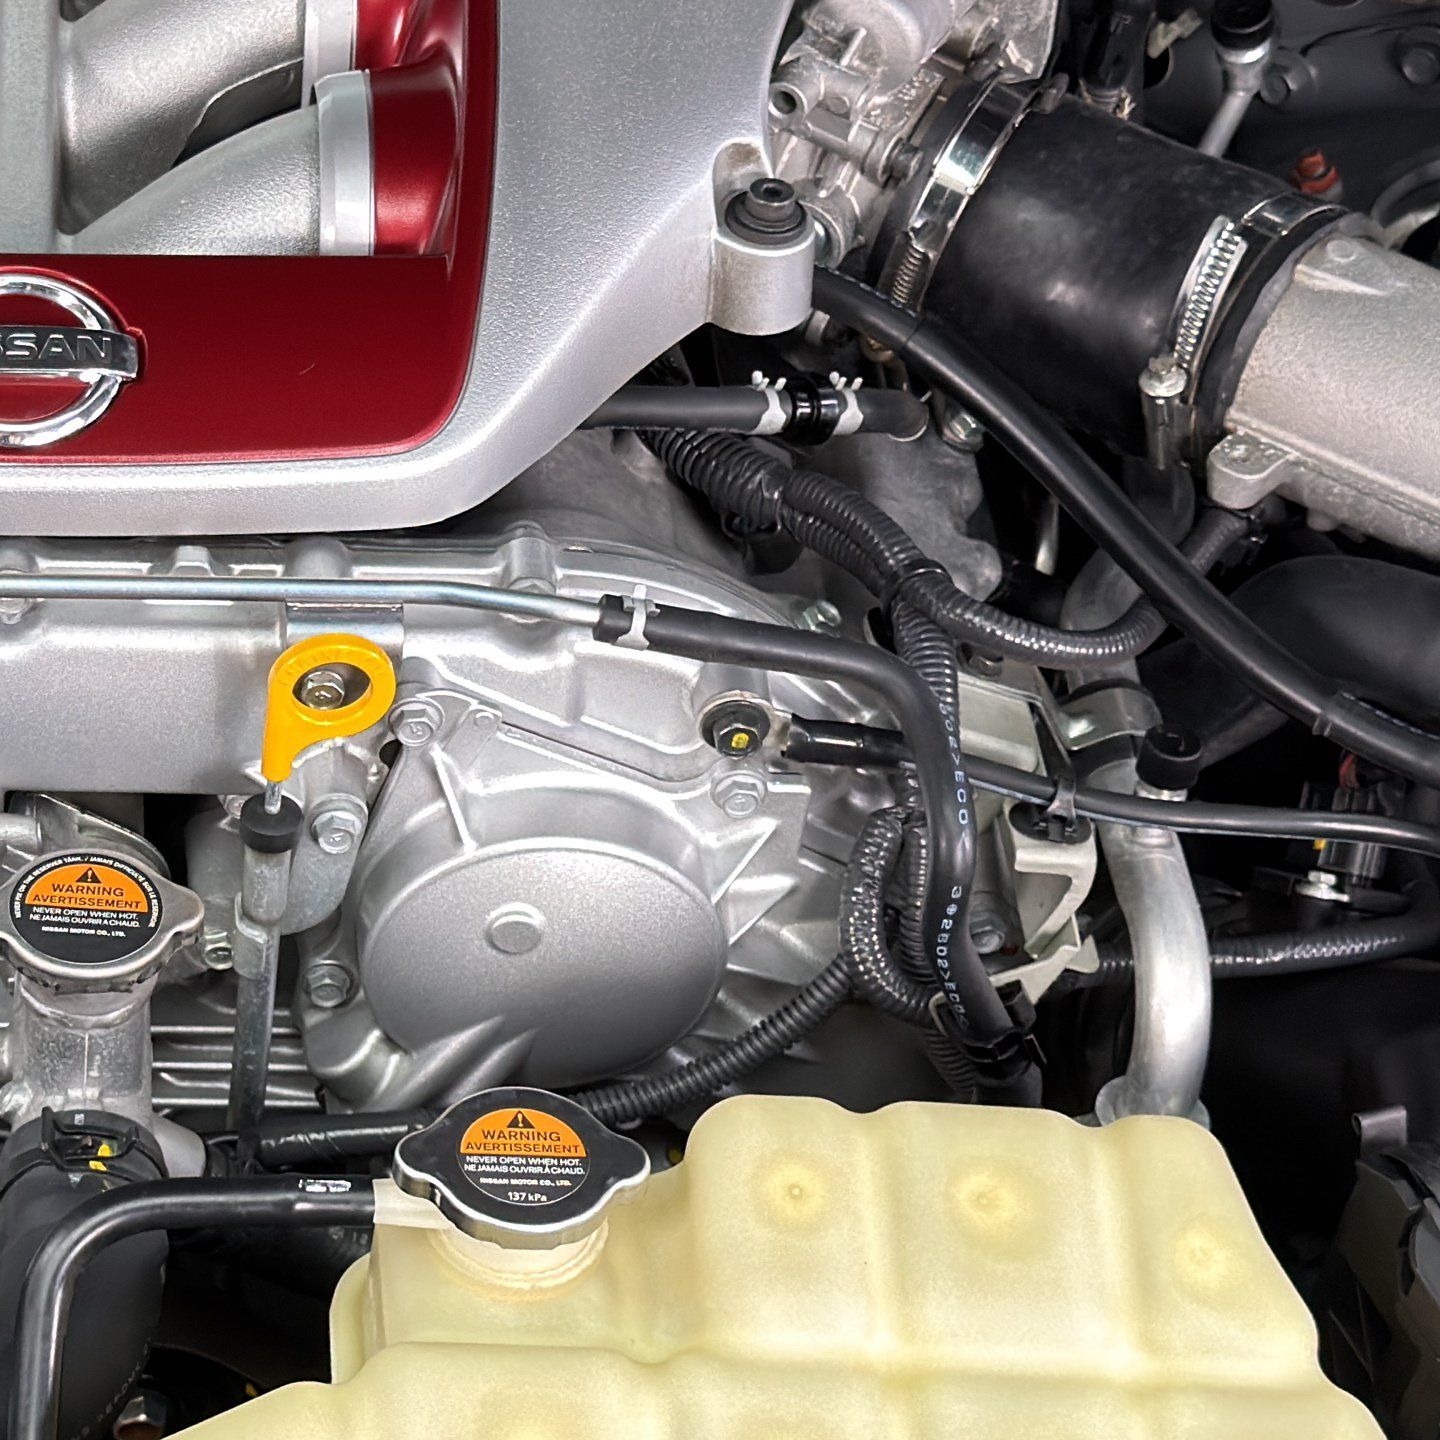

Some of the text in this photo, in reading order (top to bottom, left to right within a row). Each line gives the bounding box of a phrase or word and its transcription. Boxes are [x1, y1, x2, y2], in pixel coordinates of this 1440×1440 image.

[52, 883, 124, 897] WARNING
[33, 894, 141, 909] AVERTISSEMENT
[33, 907, 139, 920] NEVER OPEN WHEN HOT.
[29, 913, 141, 928] NE JAMAIS OUVRIR CHAUD.
[482, 1129, 561, 1142] WARNING
[465, 1141, 580, 1154] AVERTISSEMENT
[466, 1156, 582, 1167] NEVER OPEN WHEN HOT.
[464, 1164, 477, 1172] NE
[476, 1164, 508, 1173] JAMAIS
[509, 1166, 544, 1174] OUVRIR
[551, 1166, 586, 1175] CHAUD.
[507, 1191, 547, 1202] 137 kPa
